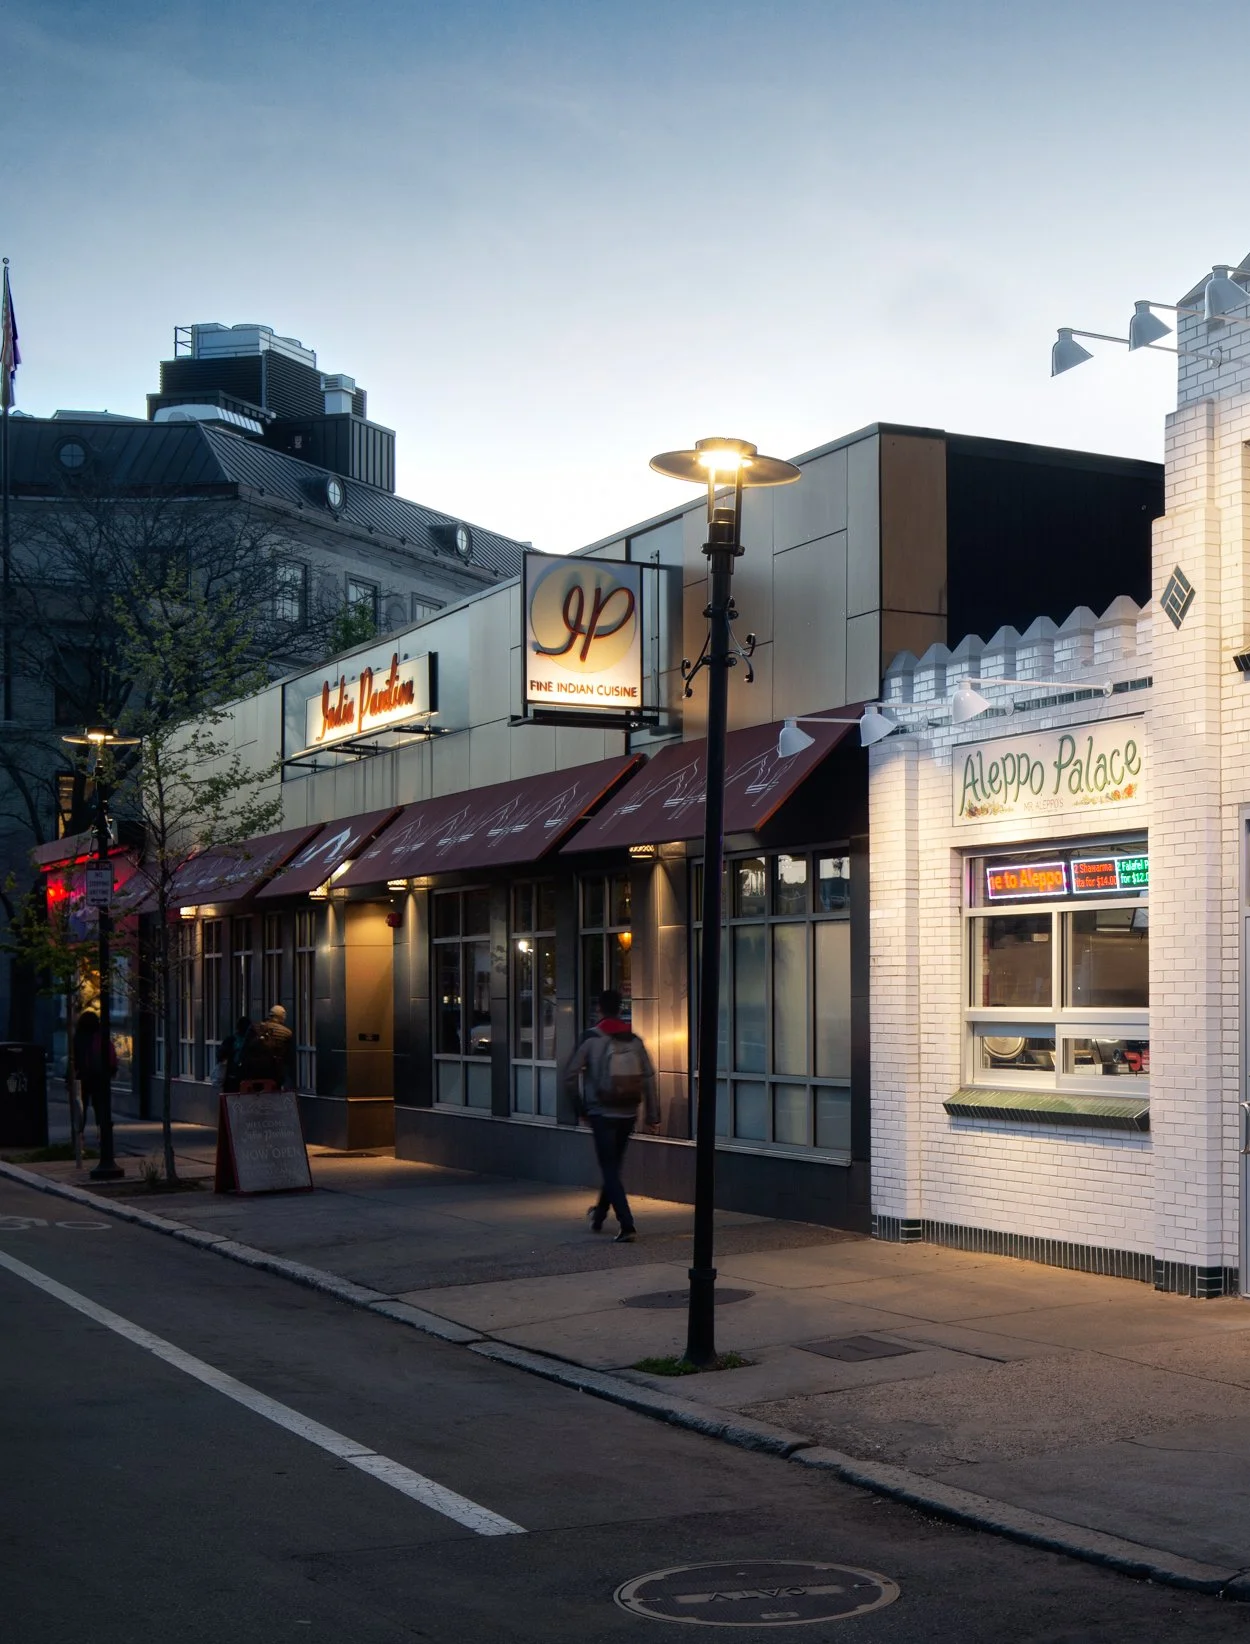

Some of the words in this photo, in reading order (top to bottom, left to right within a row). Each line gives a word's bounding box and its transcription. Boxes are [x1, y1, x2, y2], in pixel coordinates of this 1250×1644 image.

[530, 680, 553, 692] FINE
[557, 682, 594, 695] INDIAN
[597, 684, 638, 697] CUISINE
[316, 675, 354, 741] India
[357, 653, 415, 734] Pavilion
[958, 750, 1045, 816] Aleppo
[1052, 734, 1141, 794] Palace
[1079, 862, 1113, 874] Shawarma
[1121, 860, 1144, 872] Falafel
[1004, 871, 1018, 889] to
[1019, 868, 1063, 892] Aleppo
[1085, 876, 1095, 887] for
[1121, 873, 1131, 884] for
[709, 1587, 806, 1602] CATV
